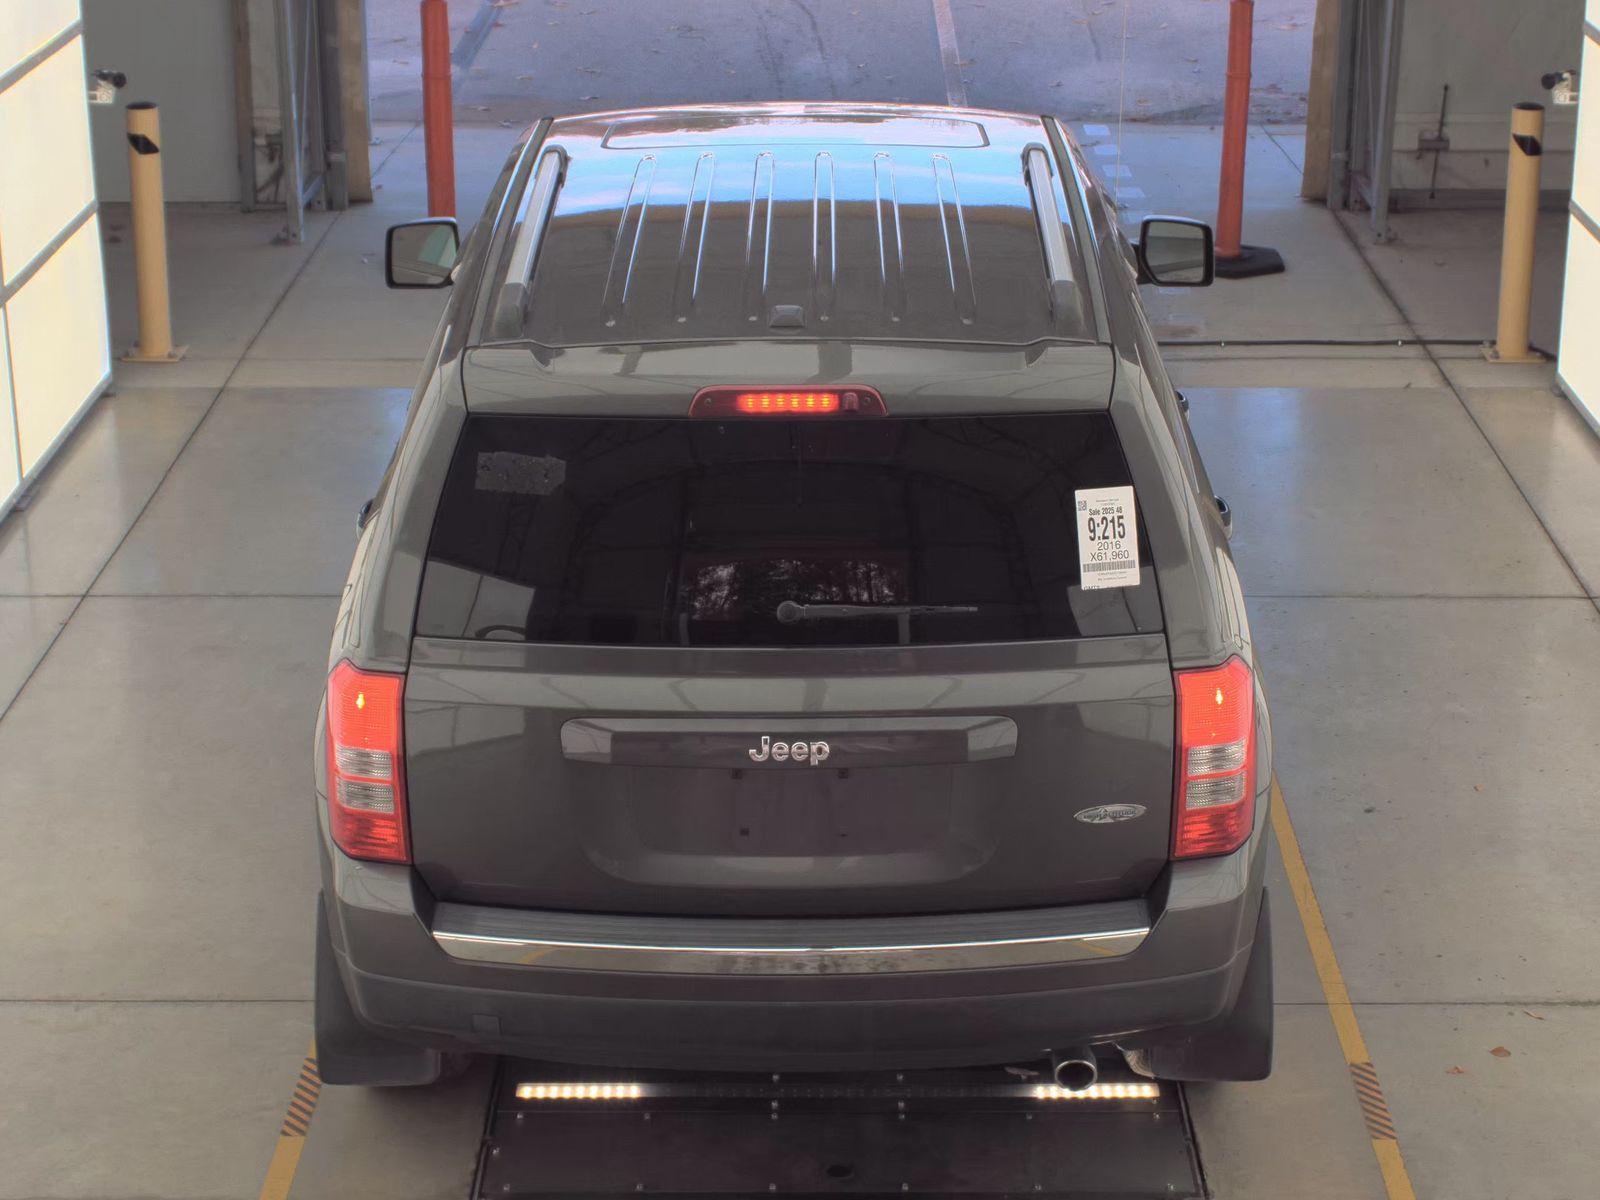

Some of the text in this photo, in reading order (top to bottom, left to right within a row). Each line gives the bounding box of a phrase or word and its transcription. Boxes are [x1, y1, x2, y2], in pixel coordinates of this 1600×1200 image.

[1089, 508, 1100, 516] Sale
[1102, 507, 1114, 515] 2025
[1088, 515, 1125, 541] 9:215
[1097, 541, 1121, 551] 2016
[1090, 550, 1129, 562] X61,960
[748, 736, 830, 766] Jeep
